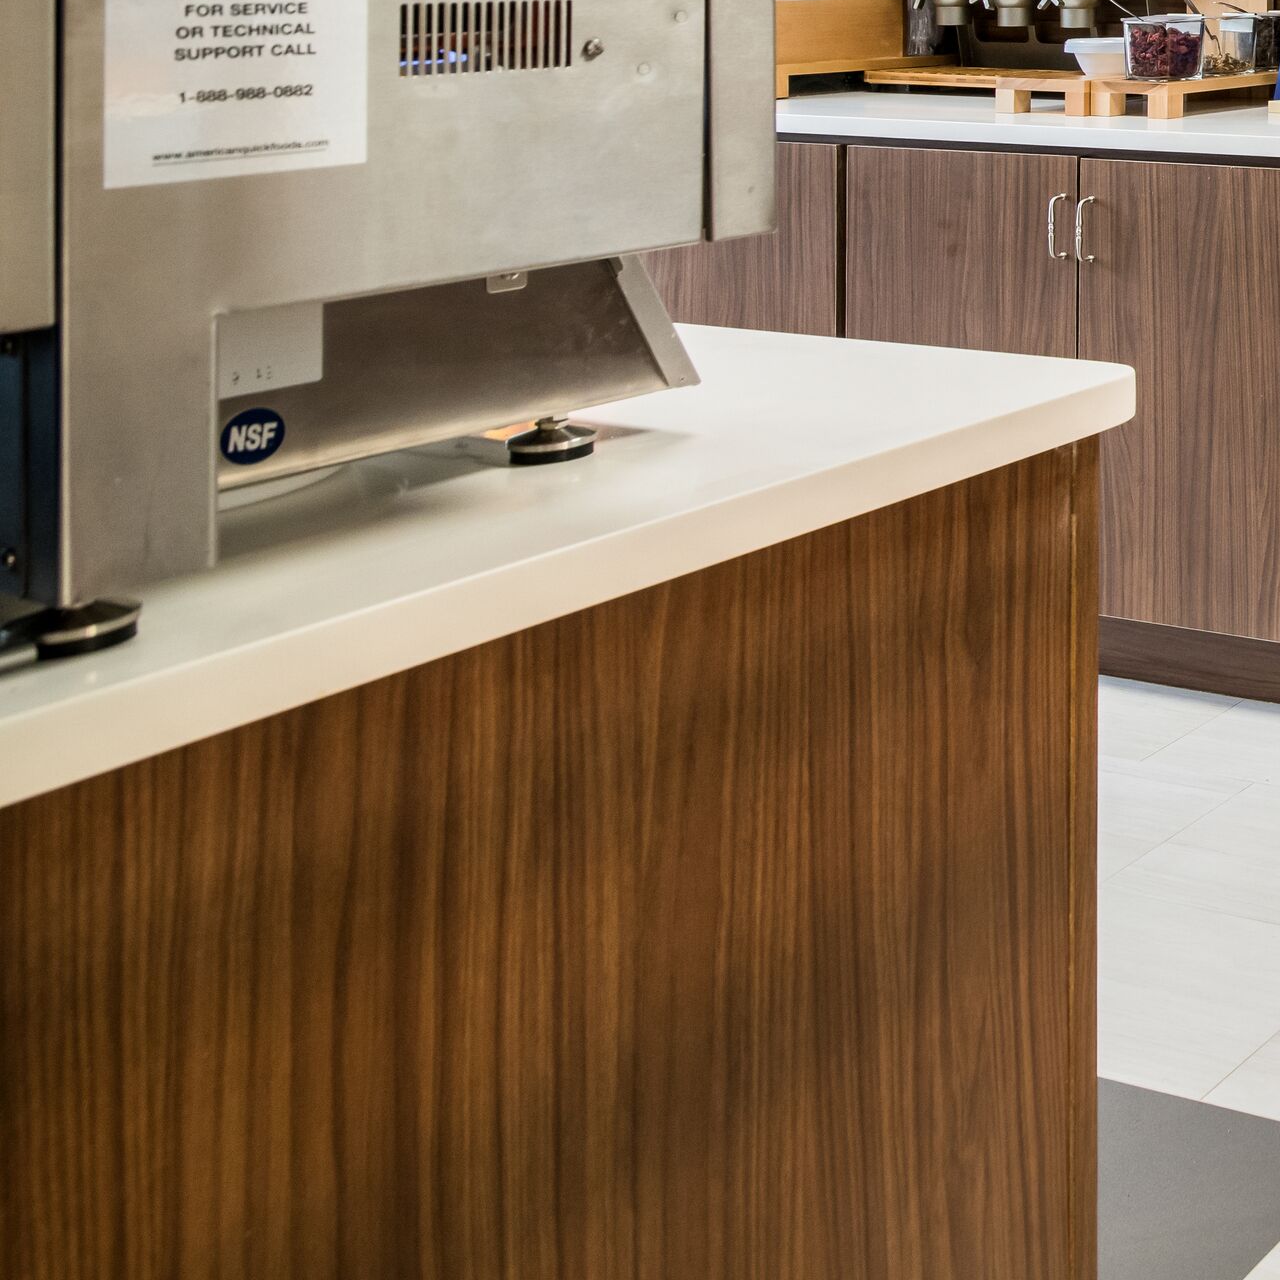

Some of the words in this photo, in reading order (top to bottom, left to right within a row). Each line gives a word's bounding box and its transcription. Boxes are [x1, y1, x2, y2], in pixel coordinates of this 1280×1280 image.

[184, 4, 224, 18] FOR
[230, 2, 309, 16] SERVICE
[175, 26, 205, 40] OR
[210, 22, 317, 38] TECHNICAL
[174, 44, 265, 62] SUPPORT
[270, 43, 317, 57] CALL
[227, 422, 278, 454] NSF
